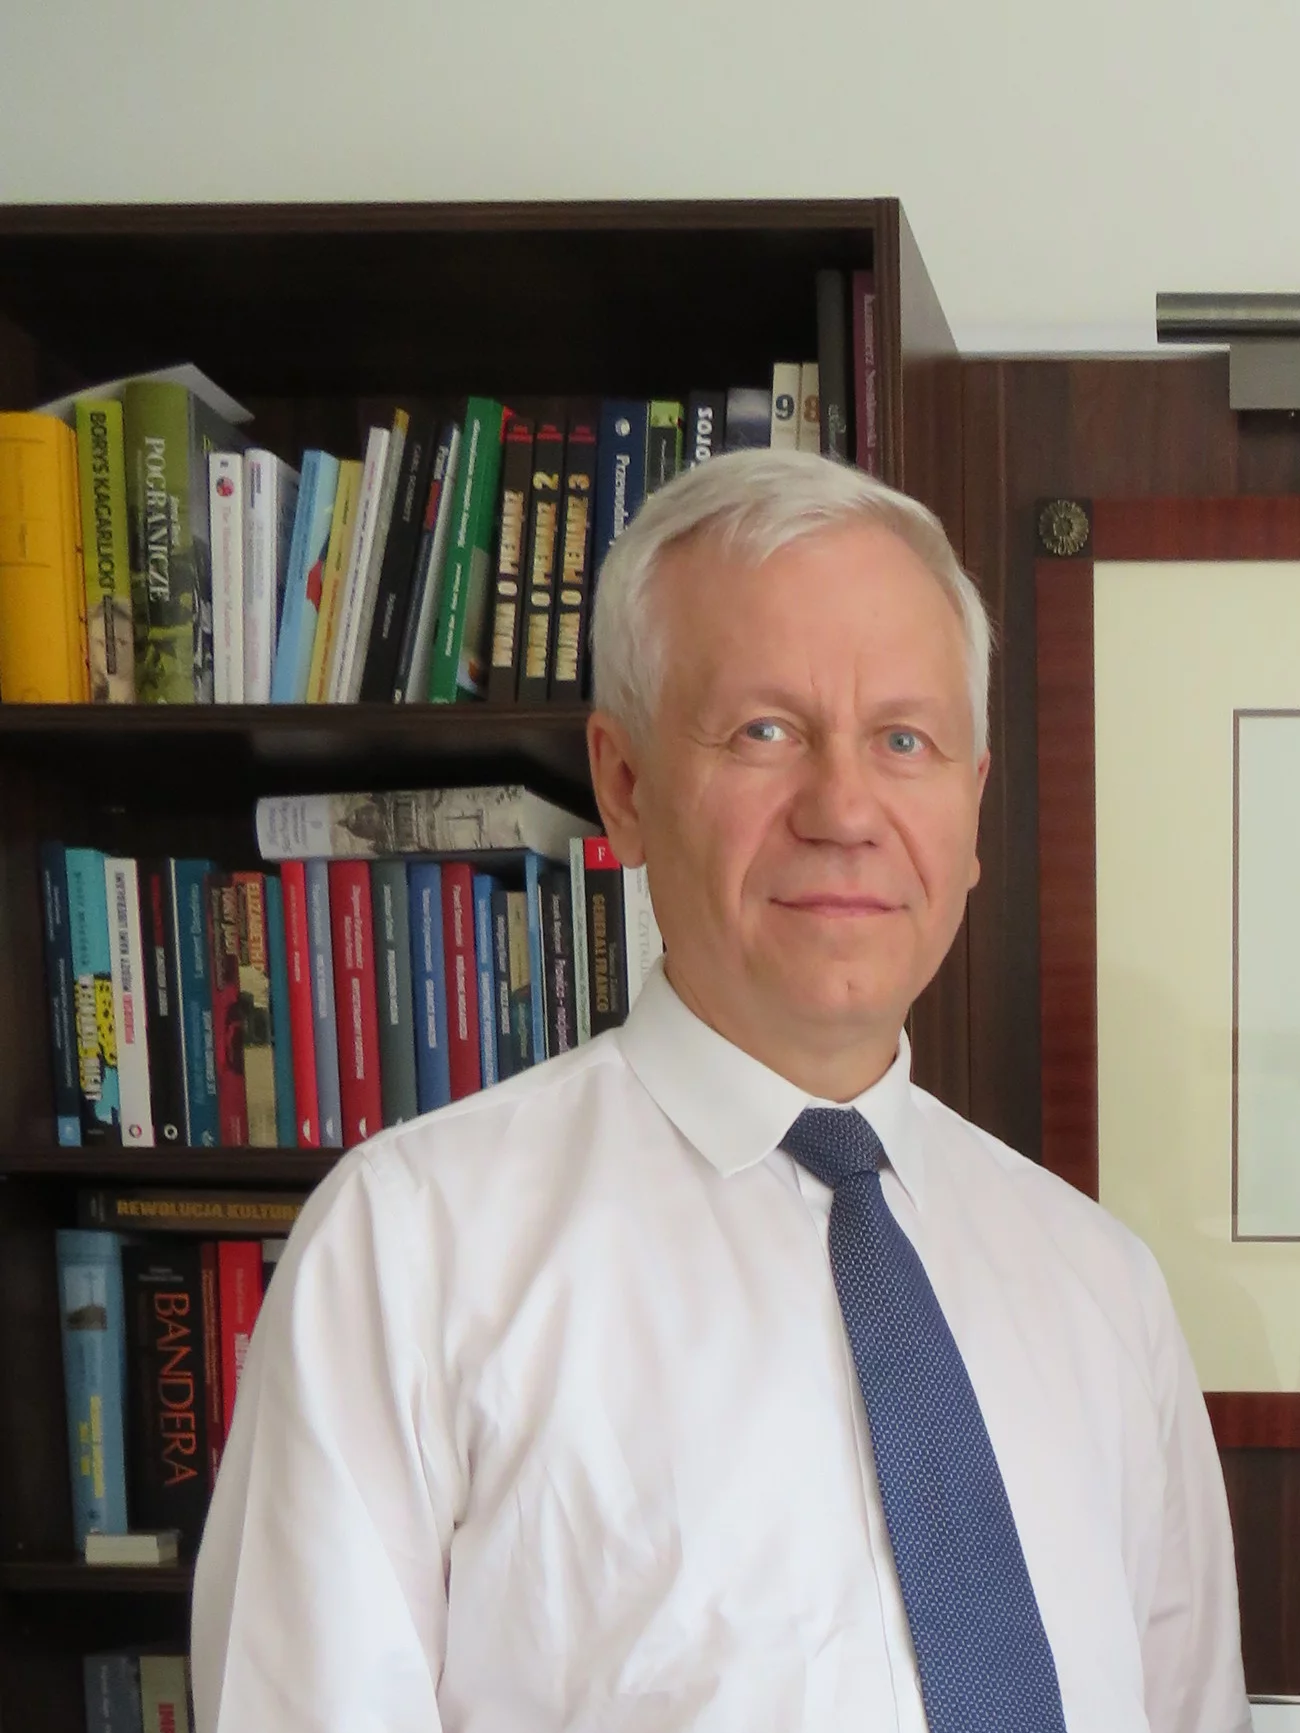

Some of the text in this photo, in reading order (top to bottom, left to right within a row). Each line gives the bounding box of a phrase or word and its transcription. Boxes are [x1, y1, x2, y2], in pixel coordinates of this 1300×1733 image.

[774, 394, 796, 421] 9
[804, 395, 820, 422] 8
[90, 411, 110, 473] BORYS
[533, 470, 559, 491] 2
[568, 473, 589, 490] 3
[144, 435, 170, 602] POGRANICZE
[596, 956, 608, 1013] FRANCO
[116, 1200, 222, 1219] REWOLUCJA
[154, 1291, 198, 1490] BANDERA
